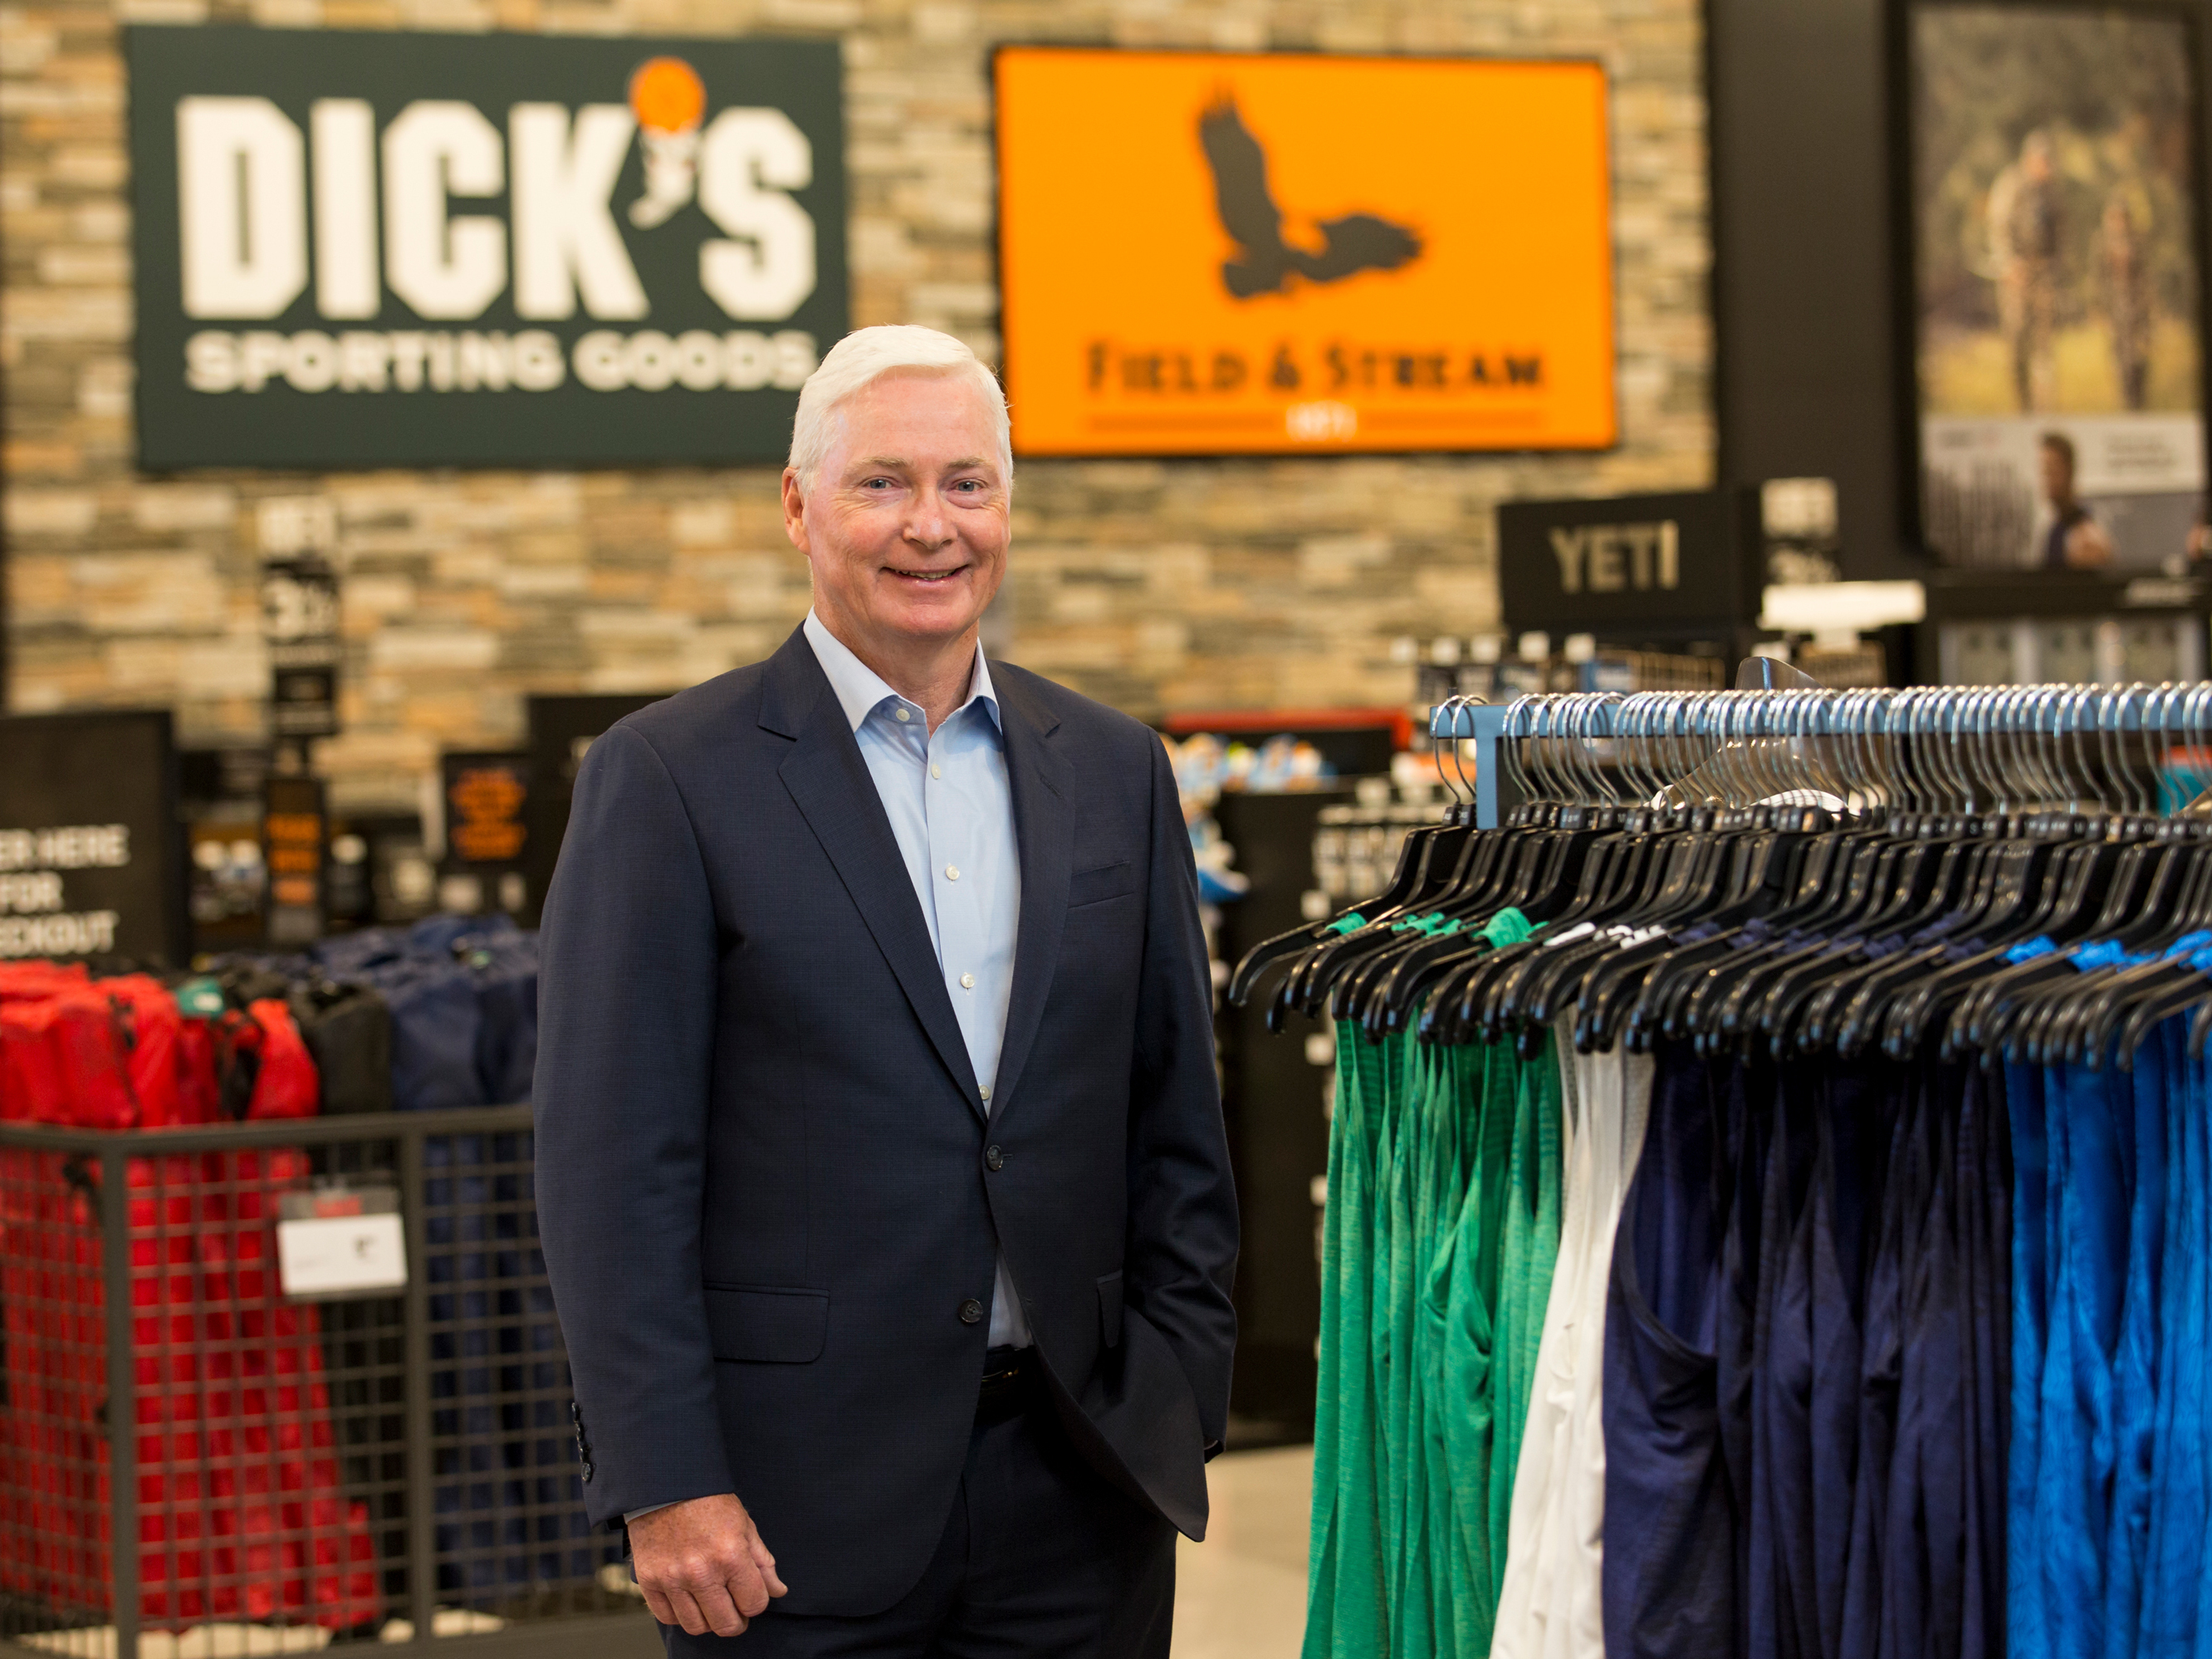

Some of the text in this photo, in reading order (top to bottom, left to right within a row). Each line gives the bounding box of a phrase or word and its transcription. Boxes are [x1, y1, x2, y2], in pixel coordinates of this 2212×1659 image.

[175, 75, 817, 322] DICK'S
[184, 330, 820, 393] SPORTING GOODS
[1087, 341, 1542, 392] FIELD & STREAM
[1549, 520, 1679, 594] YETI
[38, 824, 130, 868] HERE
[0, 871, 64, 913] FOR
